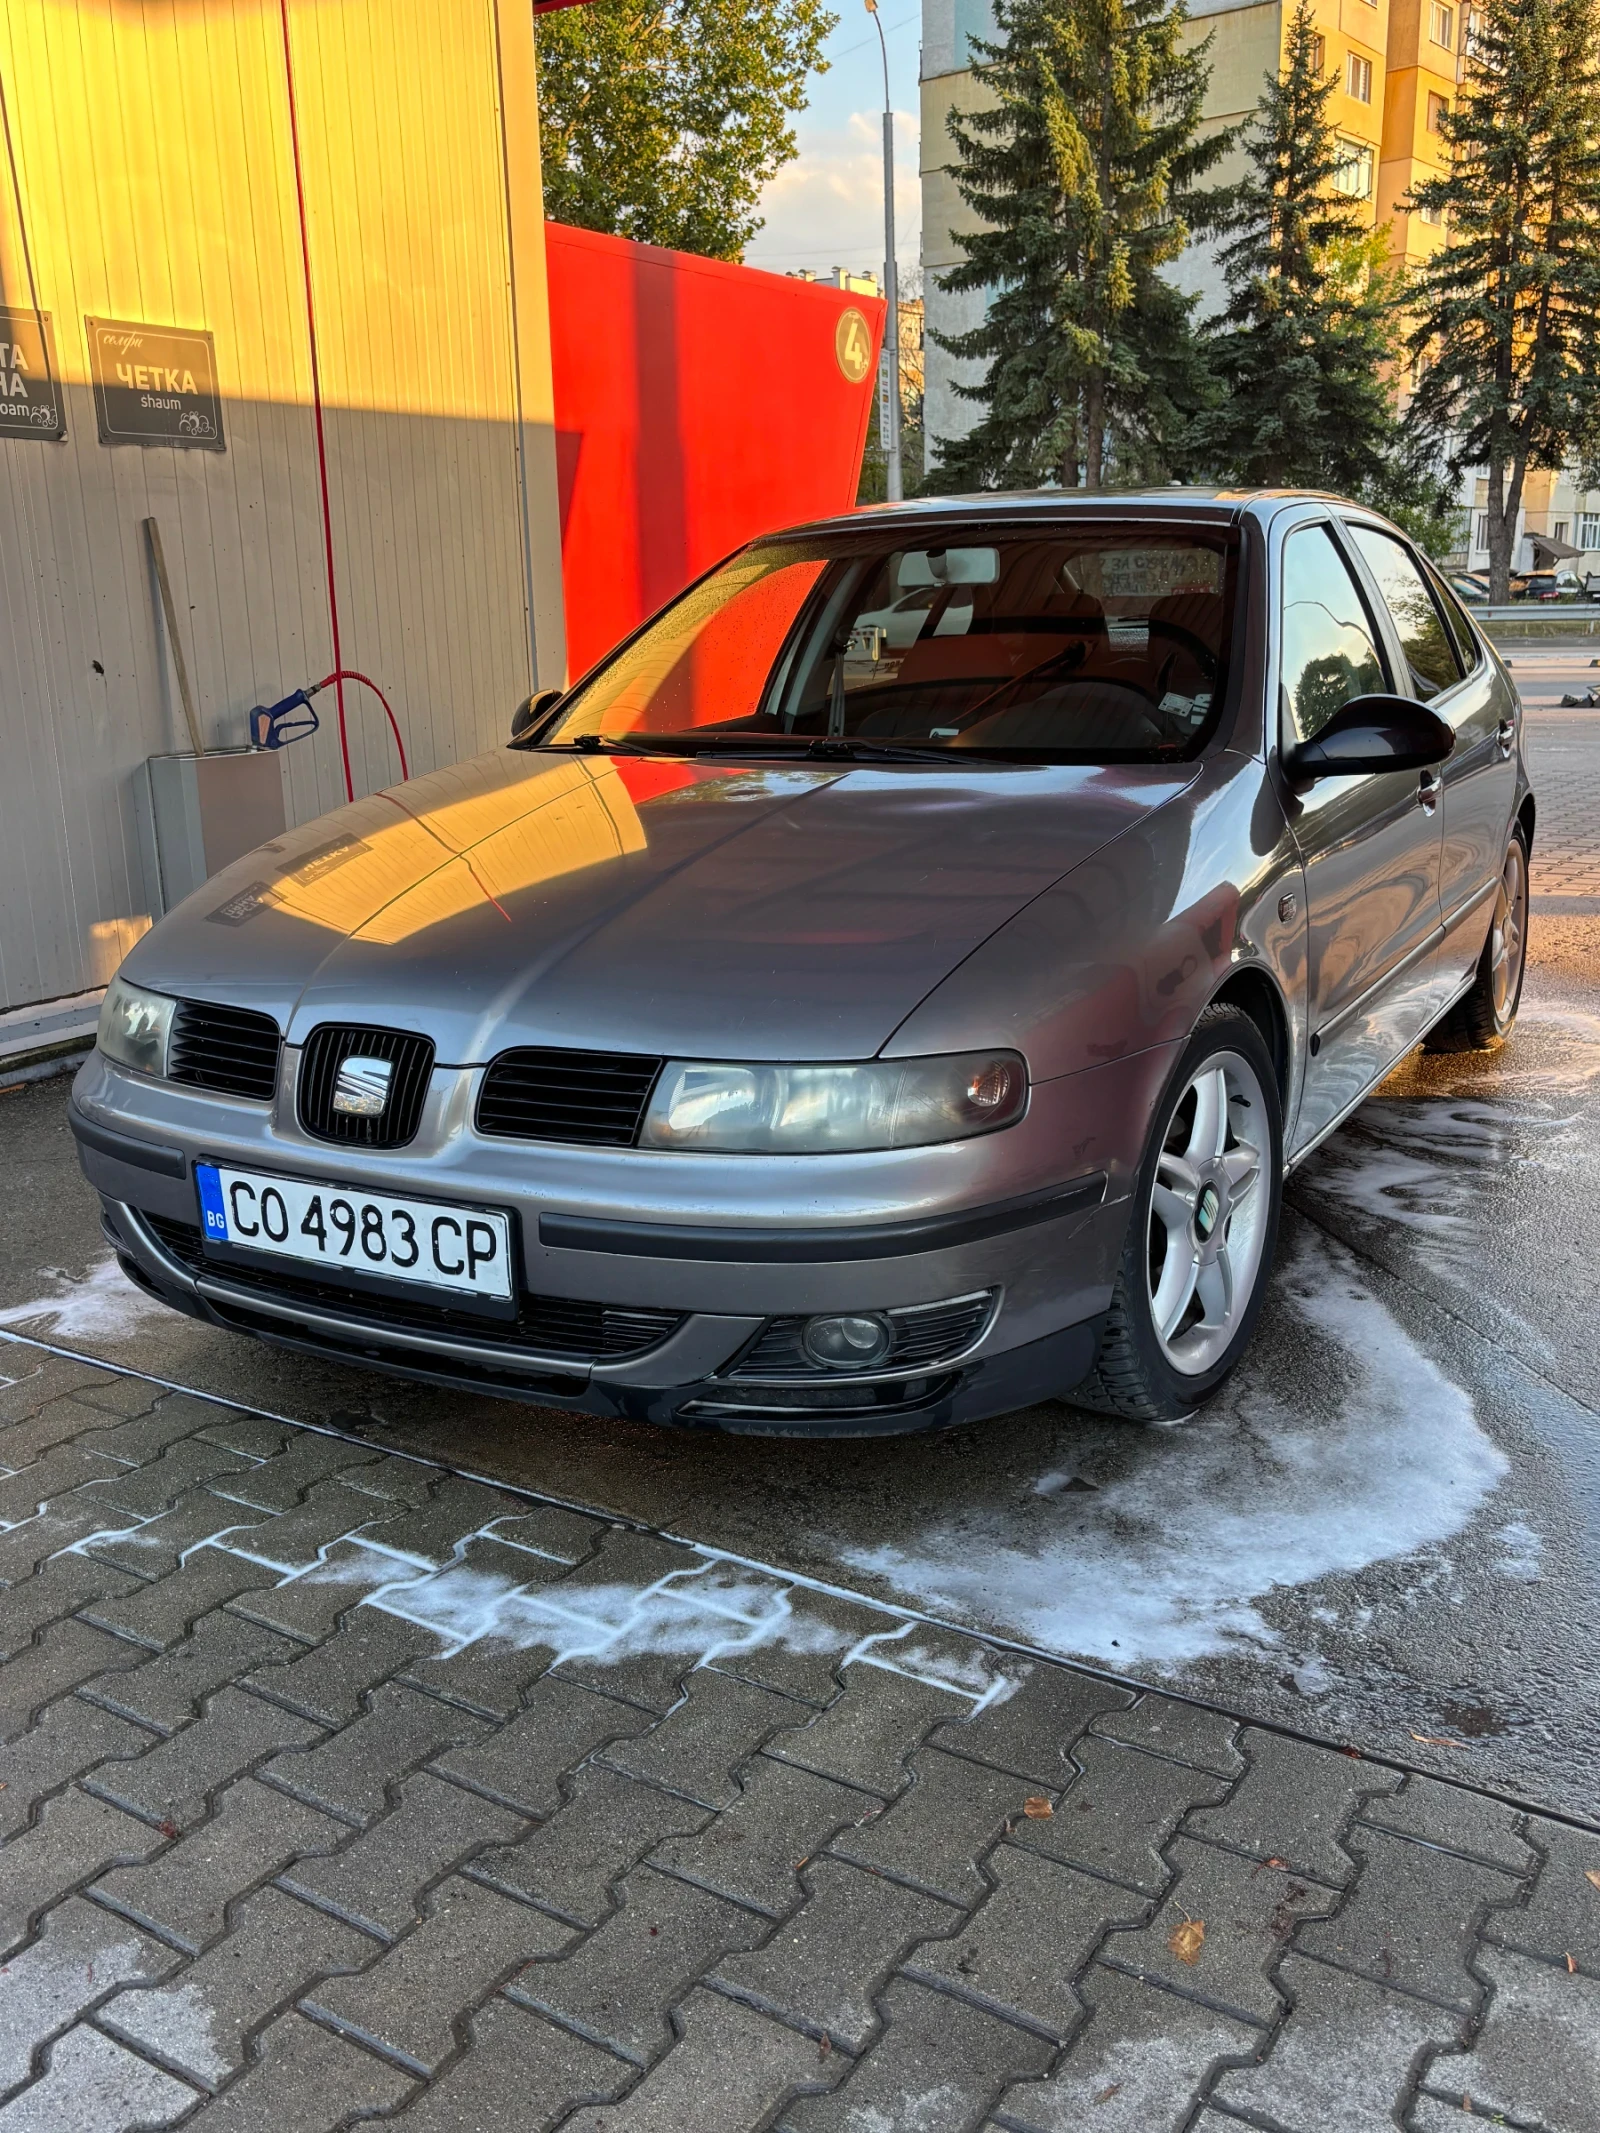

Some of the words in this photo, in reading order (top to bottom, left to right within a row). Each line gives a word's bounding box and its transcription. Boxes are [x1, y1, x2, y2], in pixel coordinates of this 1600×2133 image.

[844, 323, 863, 370] 4
[116, 363, 199, 395] ЧЕТКА
[140, 394, 182, 411] shaum
[206, 1209, 225, 1229] BG
[229, 1180, 289, 1243] CO
[300, 1194, 420, 1268] 4983
[431, 1216, 497, 1281] CP
